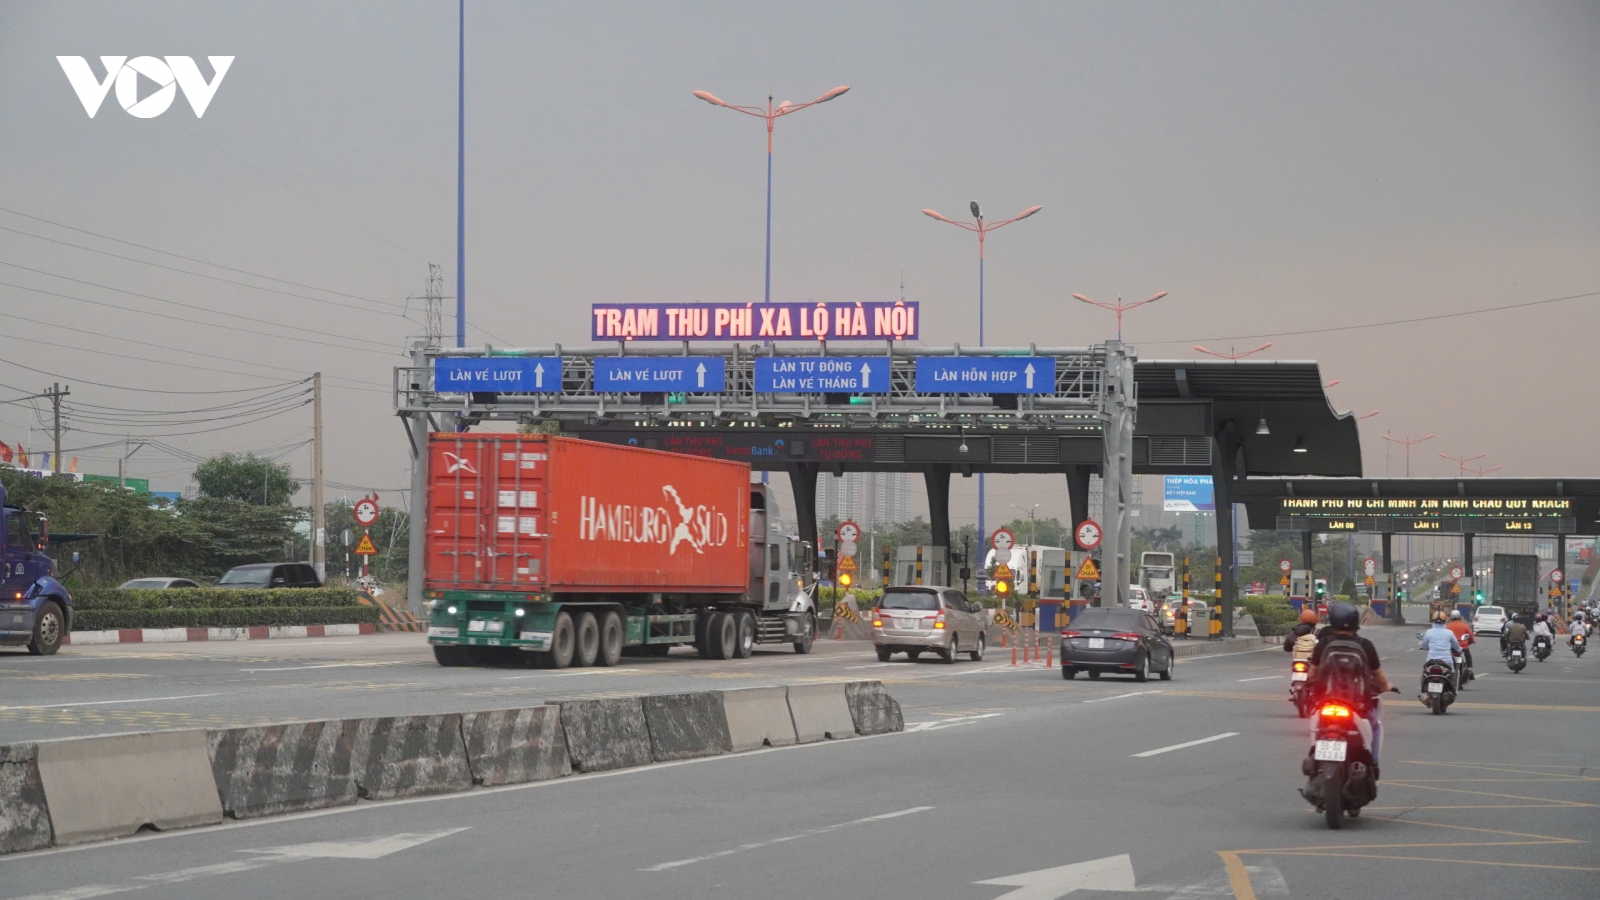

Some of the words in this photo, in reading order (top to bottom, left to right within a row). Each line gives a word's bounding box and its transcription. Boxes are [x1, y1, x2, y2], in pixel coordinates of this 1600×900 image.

[594, 308, 658, 341] TRẠM
[666, 308, 709, 337] THU
[715, 302, 753, 337] PHÍ
[759, 307, 792, 336] XA
[800, 302, 829, 340] LỘ
[835, 302, 867, 336] HÀ
[875, 301, 914, 340] NỘI
[773, 360, 796, 372] LÀN
[799, 361, 815, 374] TỰ
[818, 360, 852, 374] ĐỘNG
[450, 369, 472, 381] LÀN
[475, 368, 489, 381] VÉ
[493, 370, 523, 383] LƯỢT
[609, 368, 632, 381] LÀN
[635, 368, 649, 381] VÉ
[653, 370, 683, 383] LƯỢT
[772, 376, 796, 389] LÀN
[799, 376, 814, 389] VÉ
[817, 376, 857, 389] THÁNG
[934, 368, 957, 381] LÀN
[961, 367, 987, 381] HỖN
[991, 370, 1017, 384] HỢP
[580, 495, 667, 544] HAMBURG
[1329, 521, 1344, 529] LÀN
[1345, 521, 1354, 529] 09
[1413, 521, 1429, 529] LÀN
[1431, 521, 1439, 529] 11
[1505, 521, 1521, 529] LÀN
[1523, 521, 1532, 529] 13
